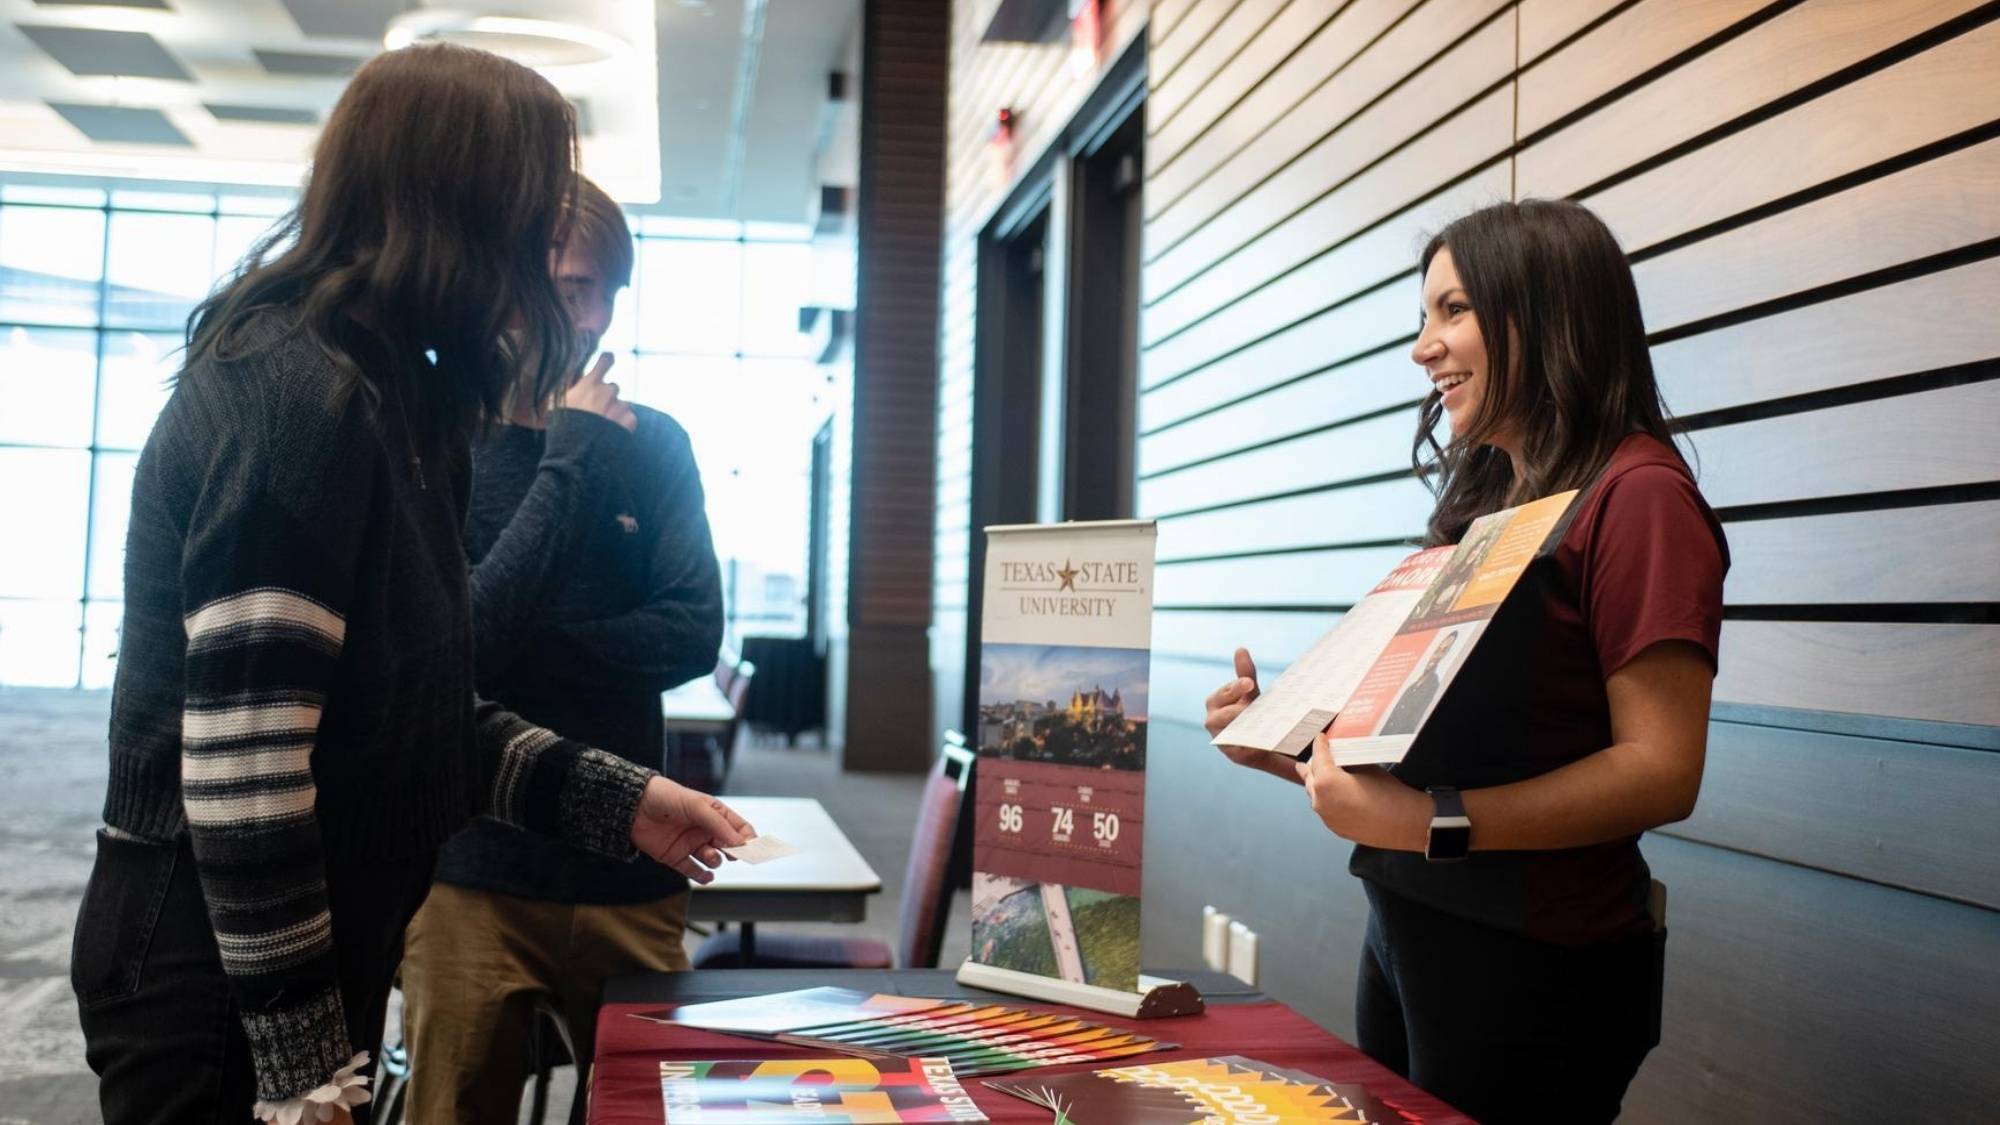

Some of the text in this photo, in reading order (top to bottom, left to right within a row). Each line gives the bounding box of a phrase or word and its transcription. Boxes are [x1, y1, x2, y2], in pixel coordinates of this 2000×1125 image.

[1001, 561, 1139, 584] TEXAS STATE
[1019, 596, 1116, 617] UNIVERSITY
[999, 803, 1023, 833] 96
[1051, 806, 1119, 841] 74 50
[919, 1055, 967, 1094] TEXAS
